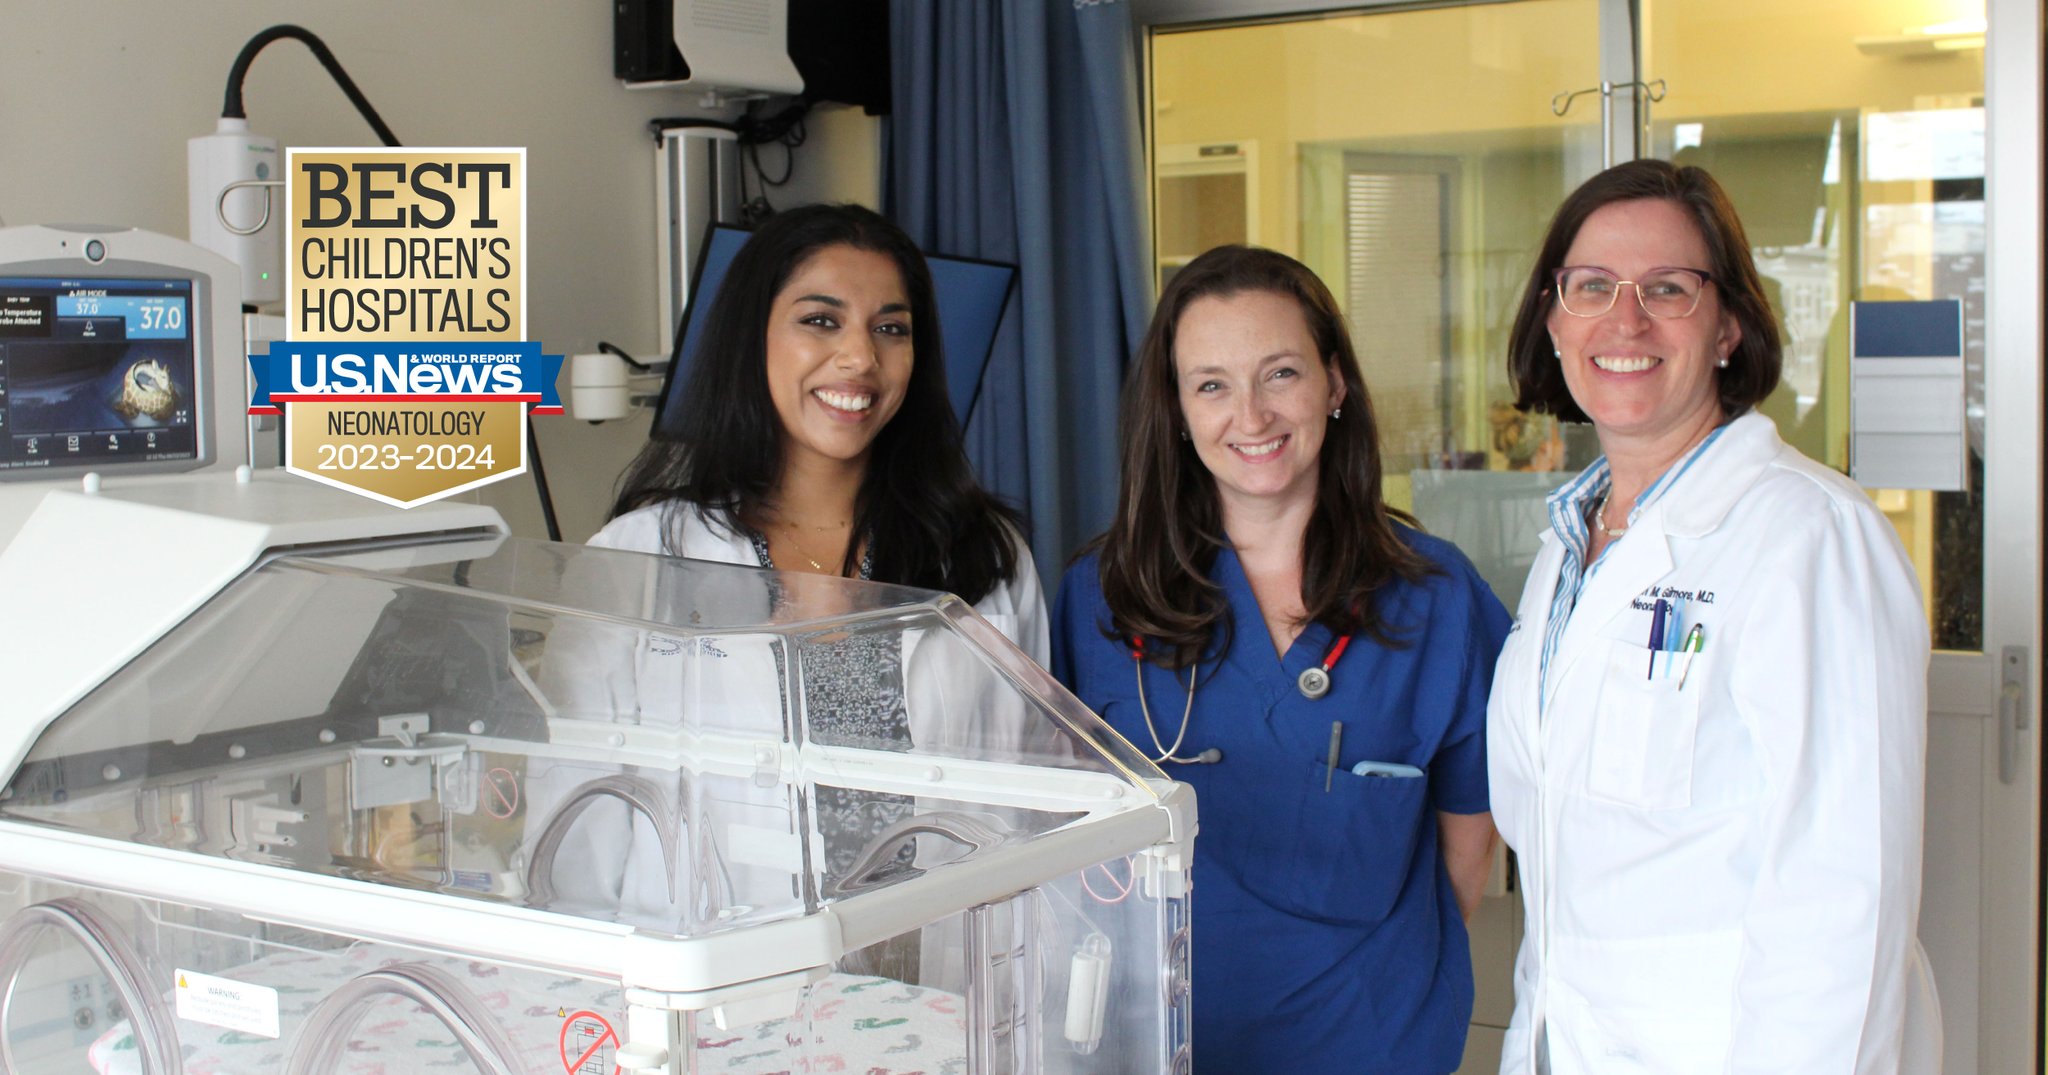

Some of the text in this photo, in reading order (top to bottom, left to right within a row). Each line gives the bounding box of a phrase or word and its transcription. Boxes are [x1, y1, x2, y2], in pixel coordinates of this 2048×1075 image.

[4, 309, 42, 318] Temperature
[76, 303, 99, 315] 37.0
[0, 317, 41, 326] robe Attached
[140, 306, 182, 331] 37.0
[207, 986, 241, 1001] WARNING
